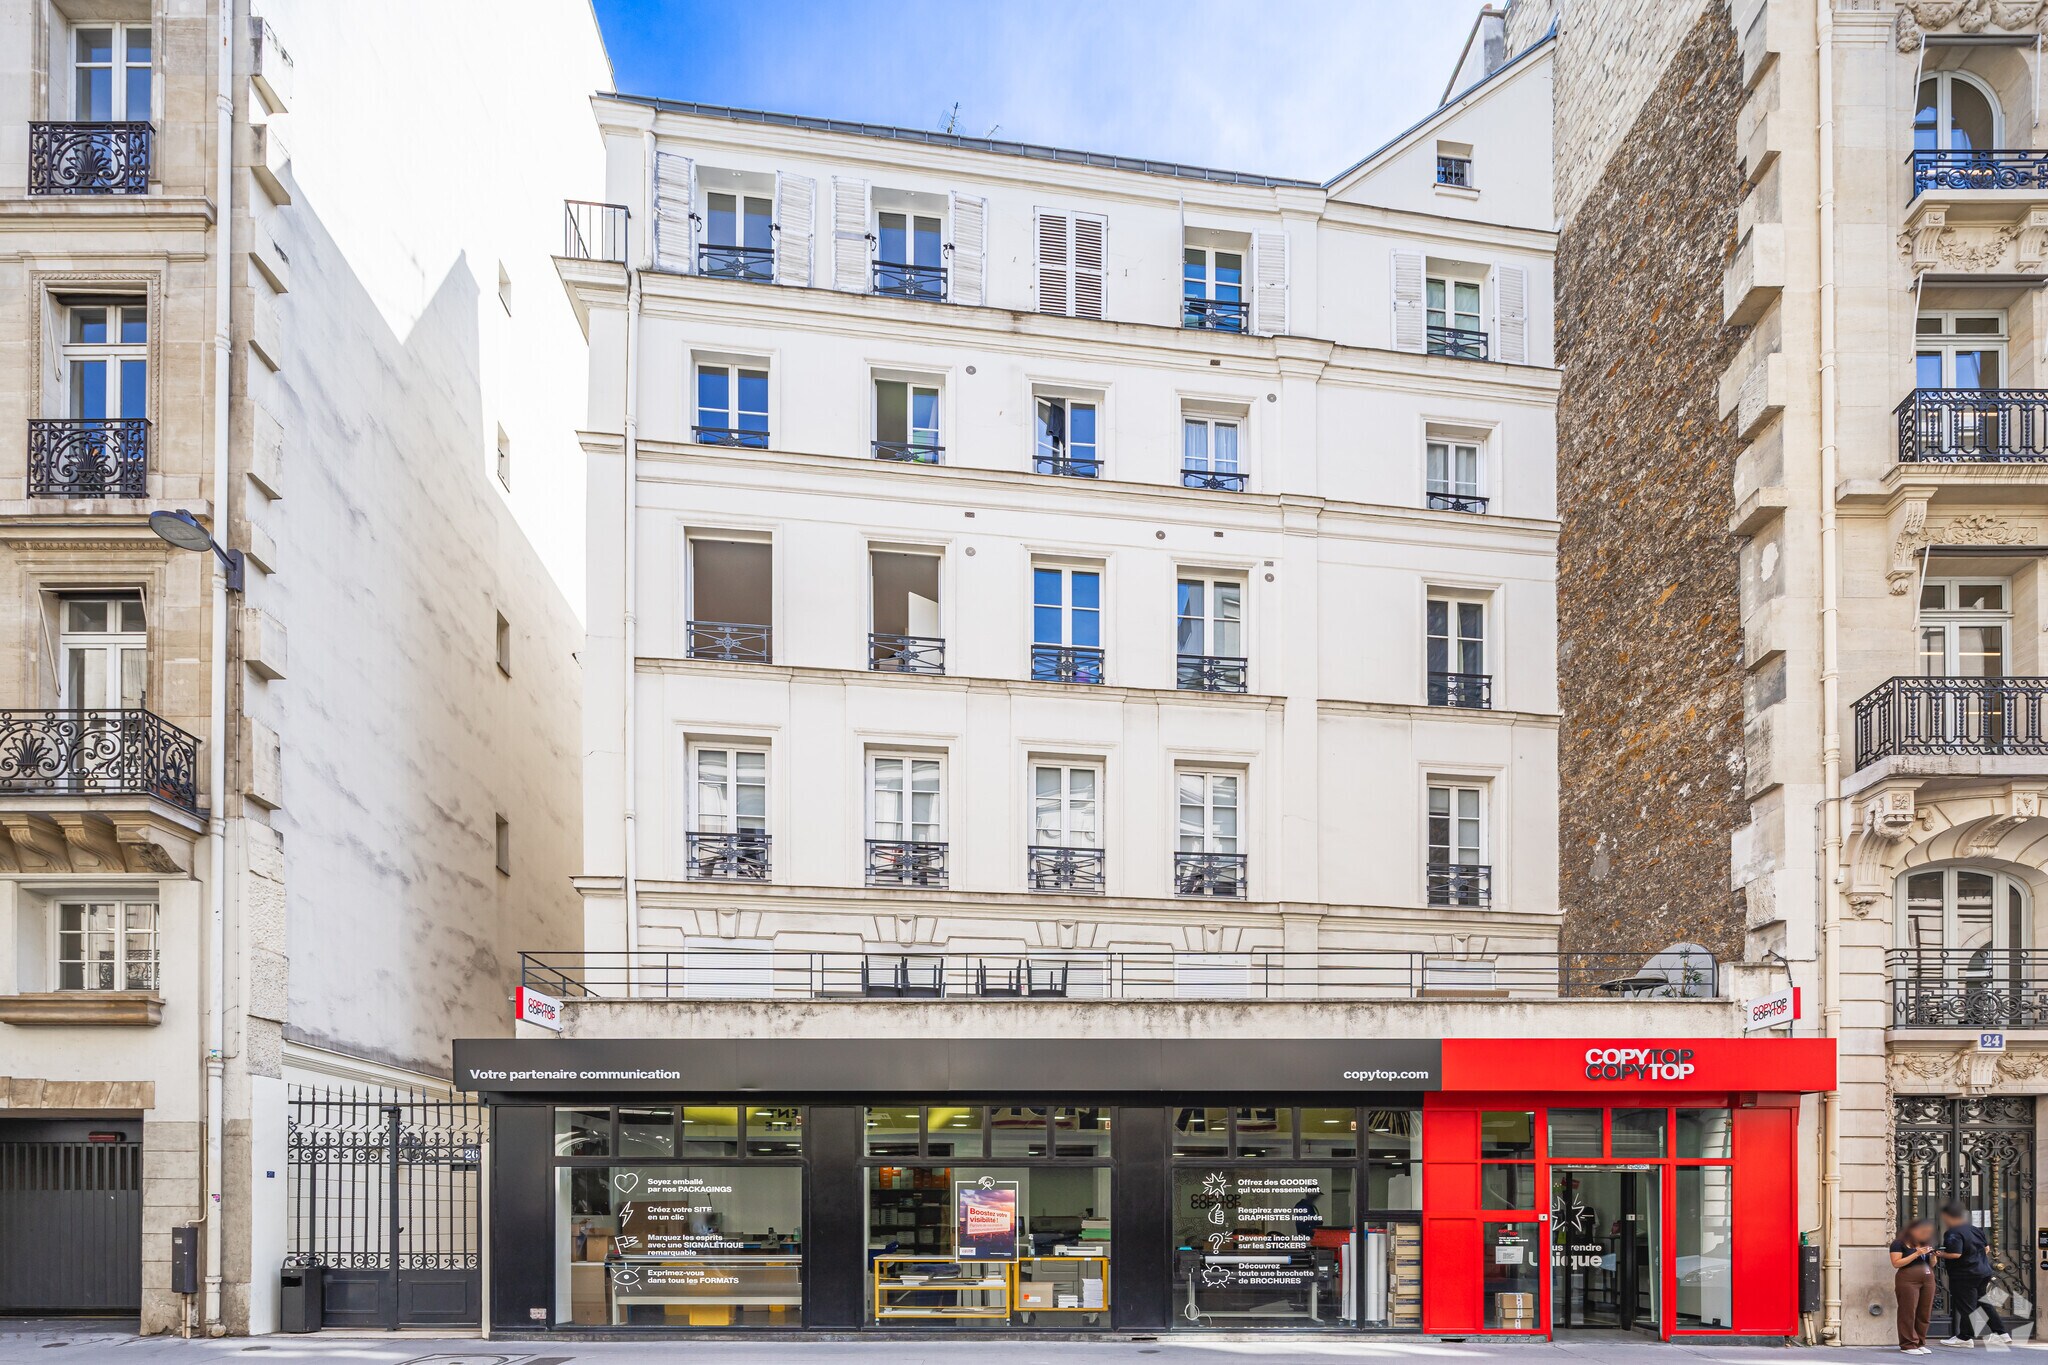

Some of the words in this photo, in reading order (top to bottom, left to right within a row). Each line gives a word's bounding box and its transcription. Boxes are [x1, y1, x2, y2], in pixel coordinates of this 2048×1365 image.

[1753, 998, 1788, 1014] COPYTOP
[1753, 1005, 1788, 1021] COPYTOP
[1983, 1034, 2000, 1047] 24
[1585, 1048, 1694, 1065] COPYTOP
[470, 1069, 507, 1080] Votre
[509, 1069, 577, 1082] partenaire
[580, 1069, 680, 1080] communication
[1343, 1069, 1429, 1082] copytop.com
[1585, 1063, 1695, 1080] COPYTOP
[647, 1178, 672, 1186] Soyez
[1237, 1178, 1263, 1186] Offrez
[1264, 1178, 1279, 1186] des
[1280, 1178, 1318, 1186] GOODIES
[647, 1186, 661, 1194] par
[1237, 1186, 1251, 1195] qui
[1271, 1186, 1320, 1194] ressemblent
[647, 1205, 671, 1213] Créez
[969, 1207, 996, 1217] Boostez
[1237, 1206, 1272, 1215] Respirez
[670, 1213, 685, 1221] clic
[1291, 1214, 1323, 1223] inspirés
[647, 1234, 682, 1242] Marquez
[696, 1234, 723, 1242] esprits
[1238, 1234, 1272, 1242] Devenez
[683, 1240, 744, 1249] SIGNALÉTIQUE
[1570, 1243, 1602, 1252] rendre
[647, 1249, 697, 1257] remarquable
[647, 1269, 705, 1277] Exprimez-vous
